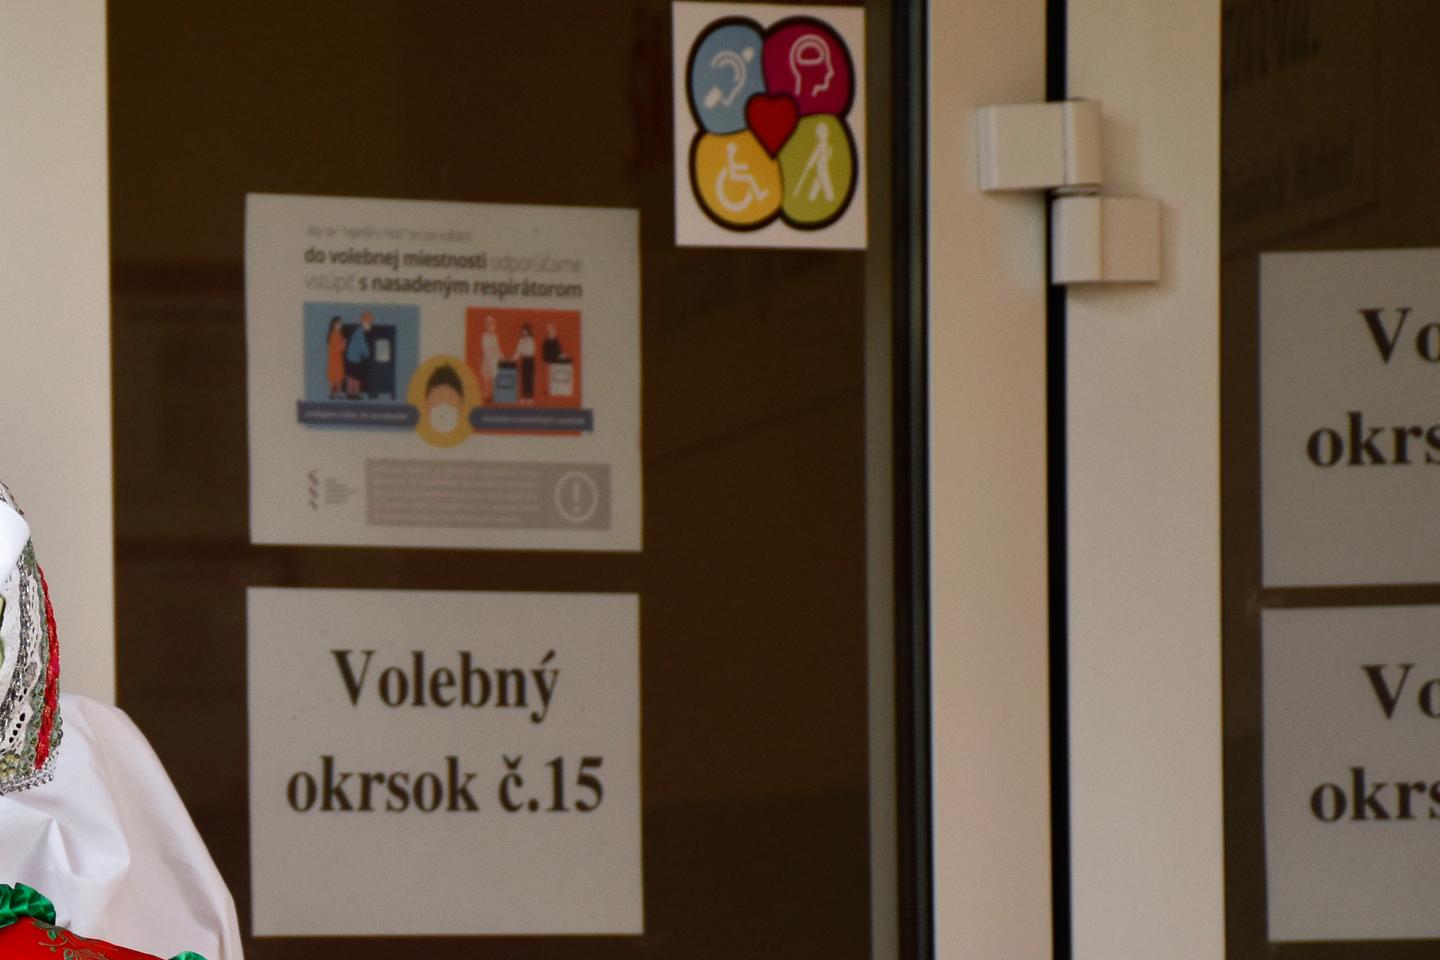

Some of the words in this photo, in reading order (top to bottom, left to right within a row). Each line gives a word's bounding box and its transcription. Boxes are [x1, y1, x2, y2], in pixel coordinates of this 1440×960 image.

[303, 245, 327, 265] do
[328, 246, 401, 272] volebnej
[402, 250, 487, 271] miestnosti
[358, 276, 369, 292] s
[370, 274, 471, 299] nasadeným
[472, 278, 584, 301] respirátorom
[331, 649, 559, 724] Volebný
[286, 755, 479, 812] okrsok
[498, 755, 603, 813] č.15
